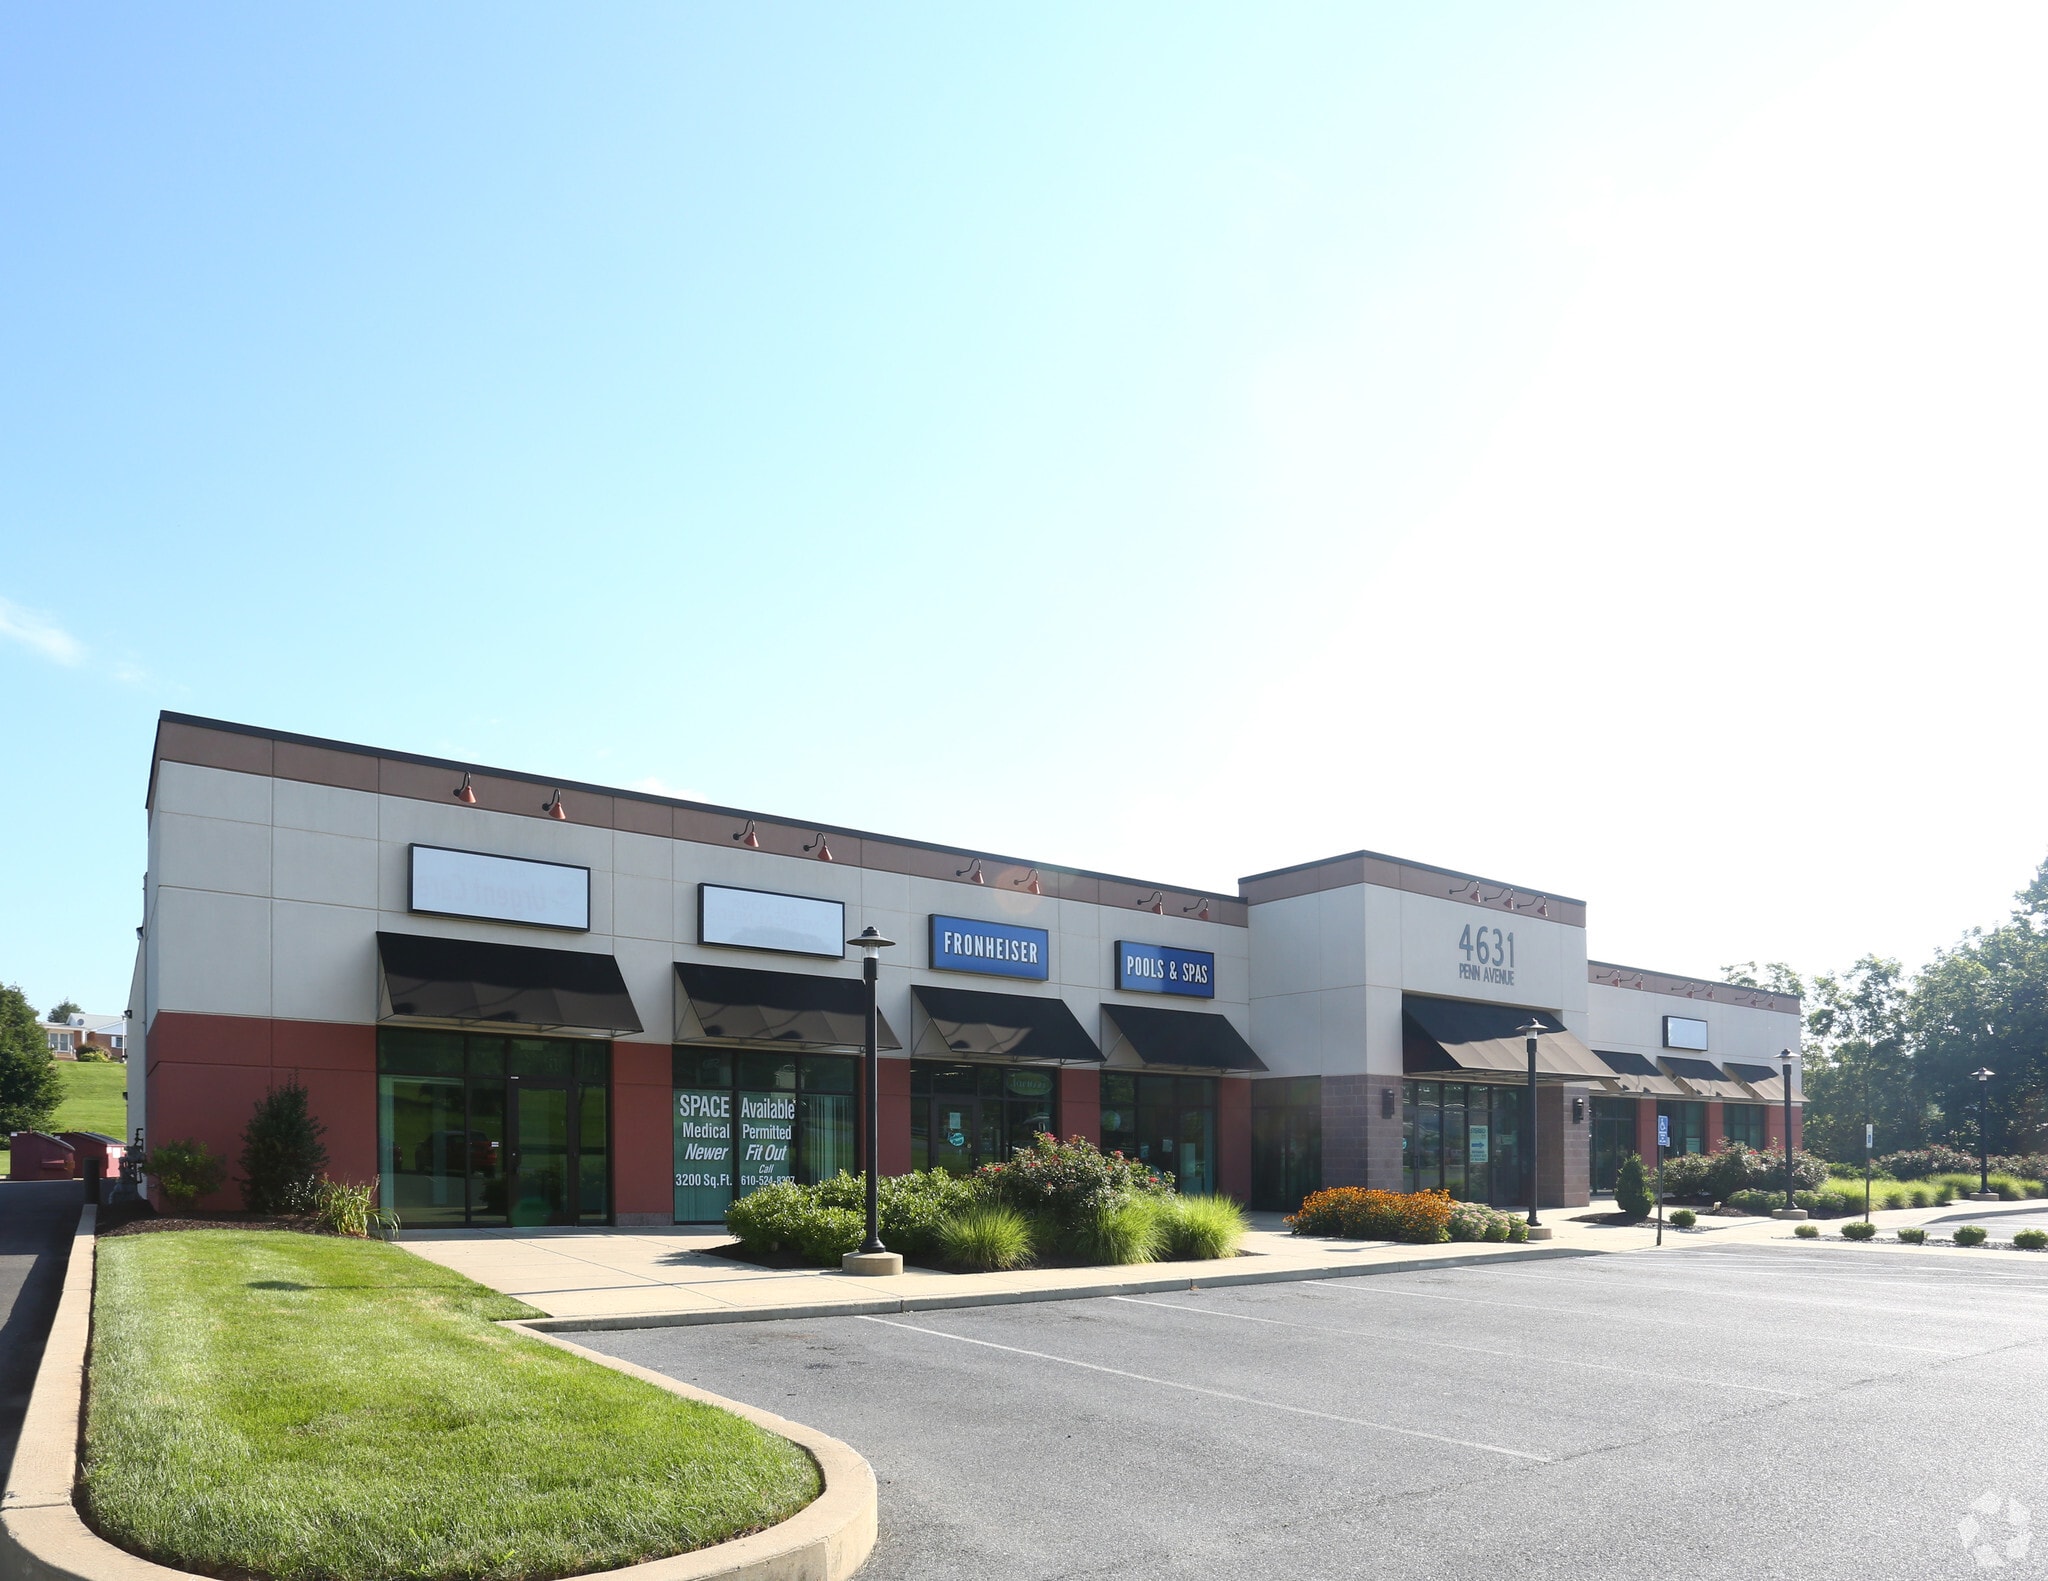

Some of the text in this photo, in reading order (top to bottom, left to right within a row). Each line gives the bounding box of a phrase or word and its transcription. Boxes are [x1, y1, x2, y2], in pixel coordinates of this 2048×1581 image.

[944, 931, 1038, 964] FRONHEISER
[1458, 923, 1515, 968] 4631
[1127, 955, 1208, 984] POOLS & SPAS
[1459, 963, 1515, 986] PENN AVENUE
[680, 1094, 795, 1120] SPACE Available
[683, 1122, 792, 1140] Medical Permitted
[684, 1143, 787, 1161] Newer Fit Out
[758, 1164, 774, 1174] Call
[675, 1173, 701, 1186] 3200
[703, 1173, 733, 1189] Sq.Ft.
